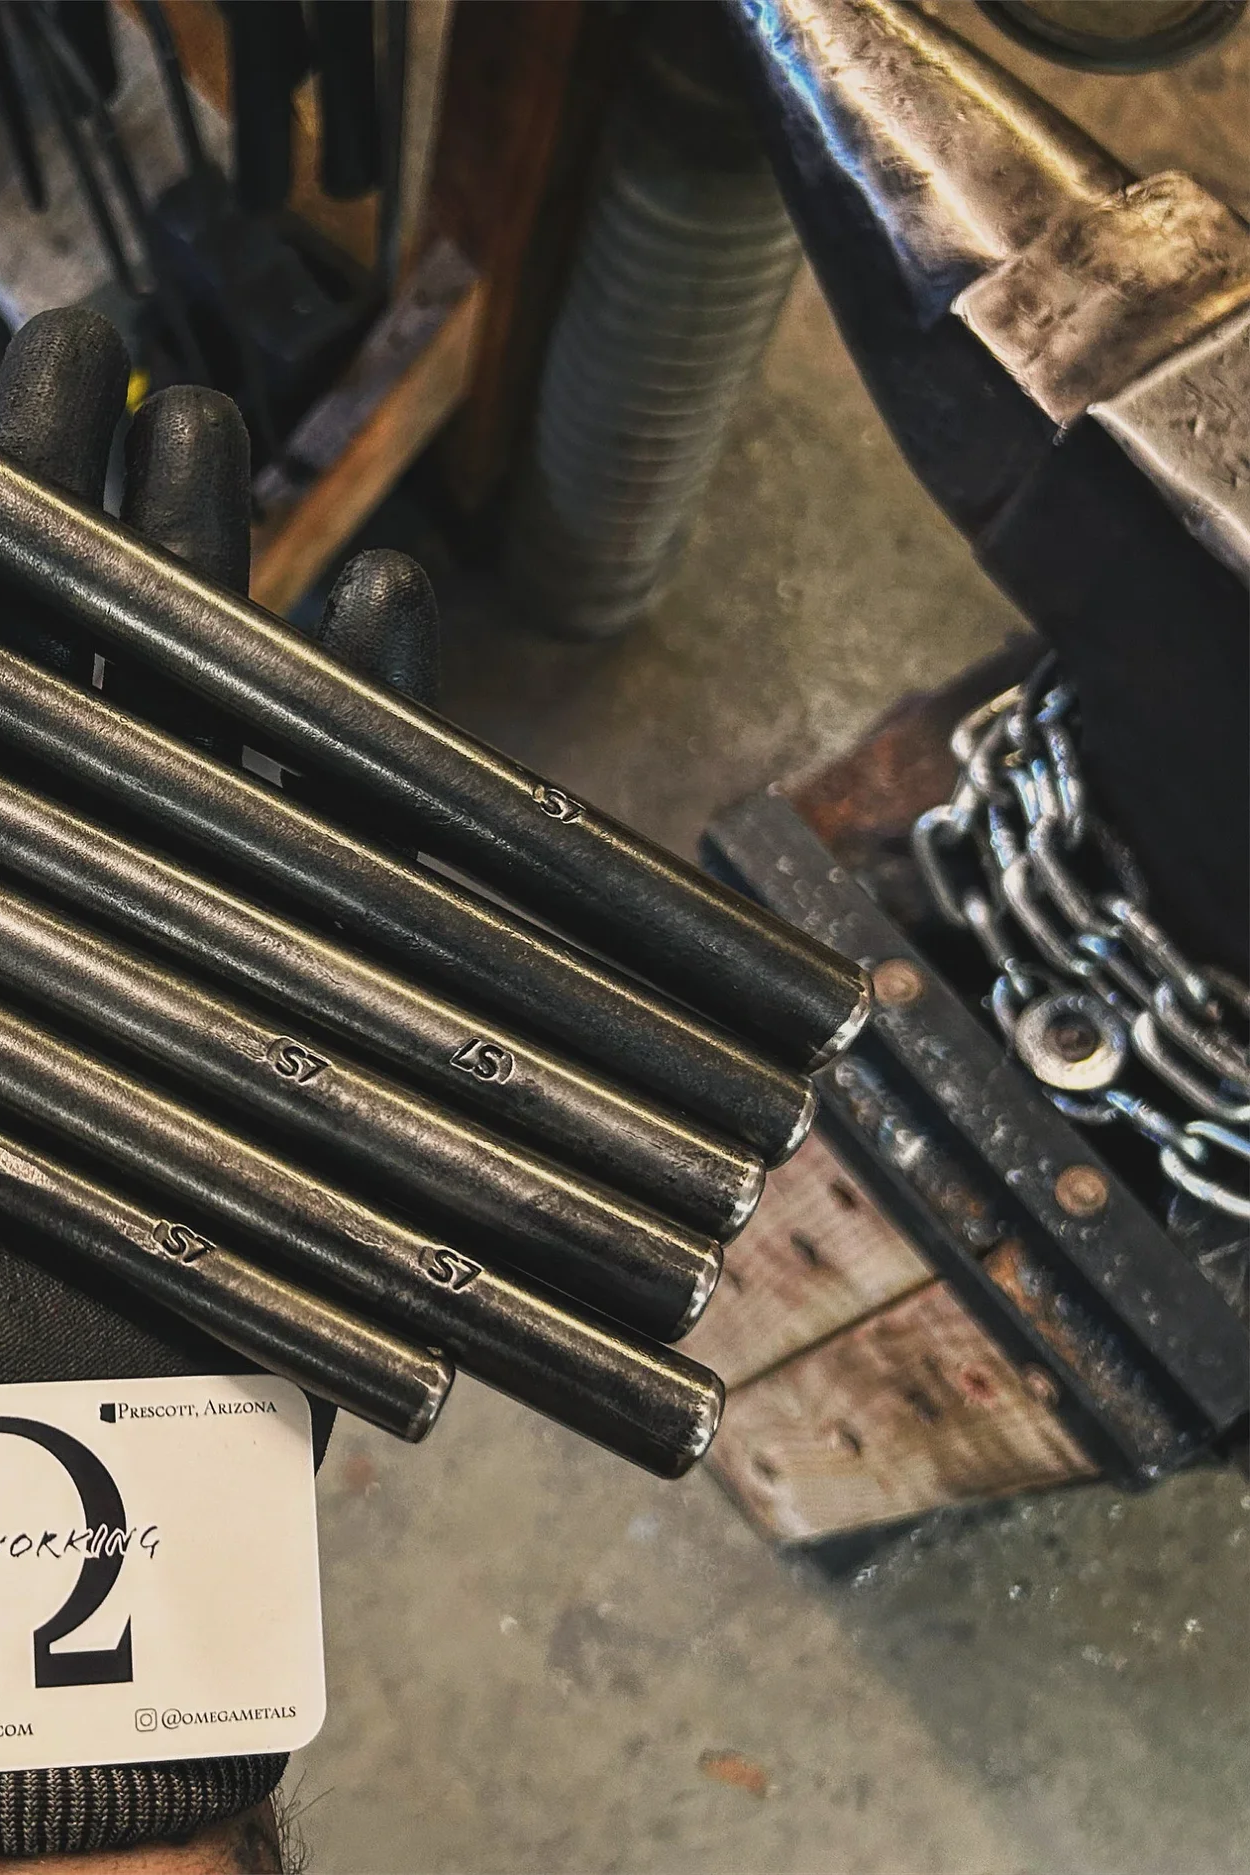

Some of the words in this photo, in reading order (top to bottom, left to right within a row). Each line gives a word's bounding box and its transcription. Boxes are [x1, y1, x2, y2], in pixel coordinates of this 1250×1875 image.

[274, 1043, 330, 1084] S7
[159, 1225, 212, 1264] S7
[427, 1248, 482, 1291] S7
[203, 1398, 278, 1416] ARIZONA
